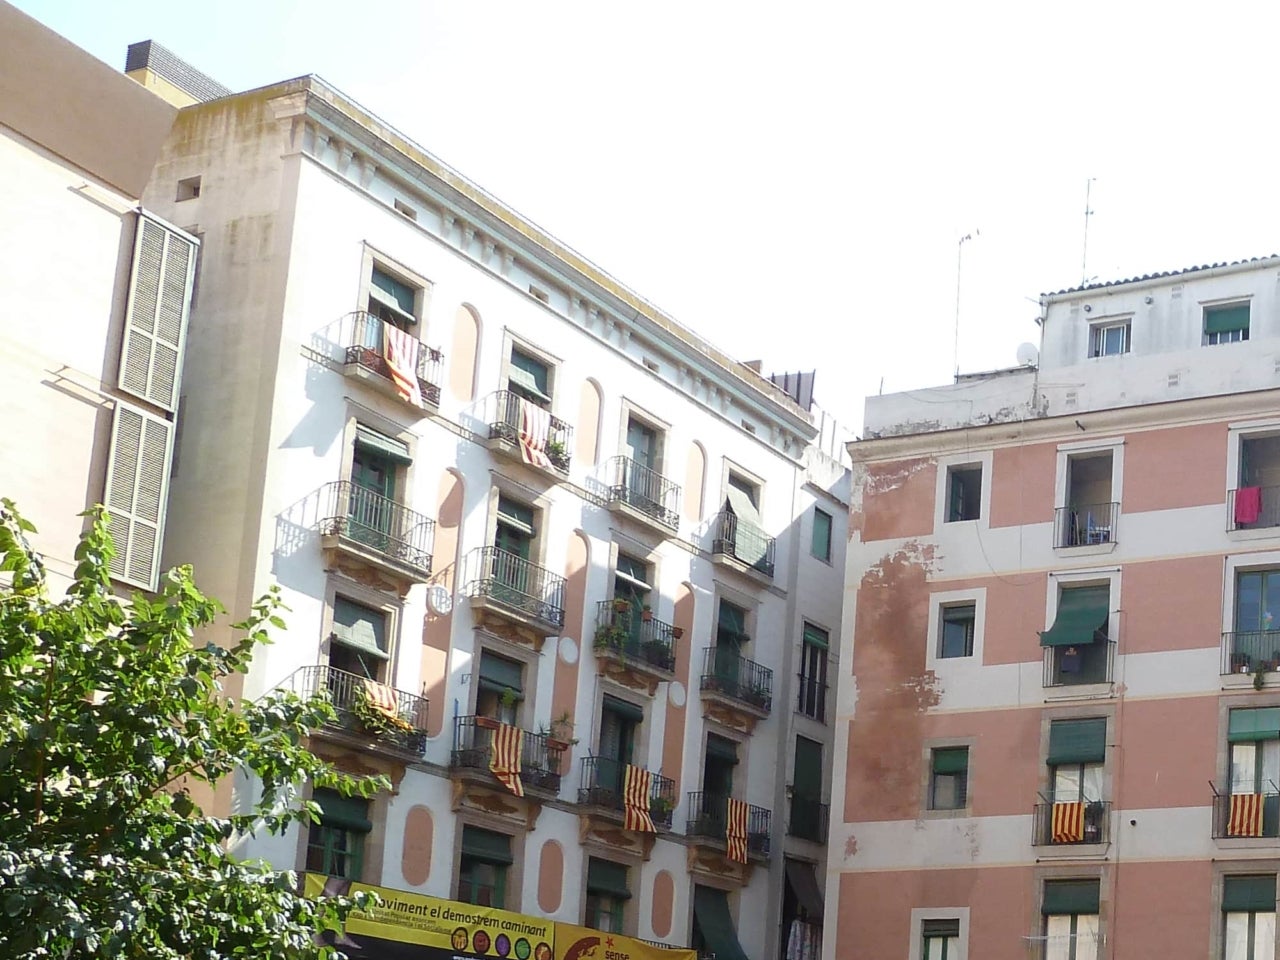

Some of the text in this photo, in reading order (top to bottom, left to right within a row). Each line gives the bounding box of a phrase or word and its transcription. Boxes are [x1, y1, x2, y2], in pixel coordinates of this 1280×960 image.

[374, 897, 428, 916] oviment
[430, 906, 441, 919] el
[442, 907, 500, 928] demostrem
[501, 919, 546, 938] caminant
